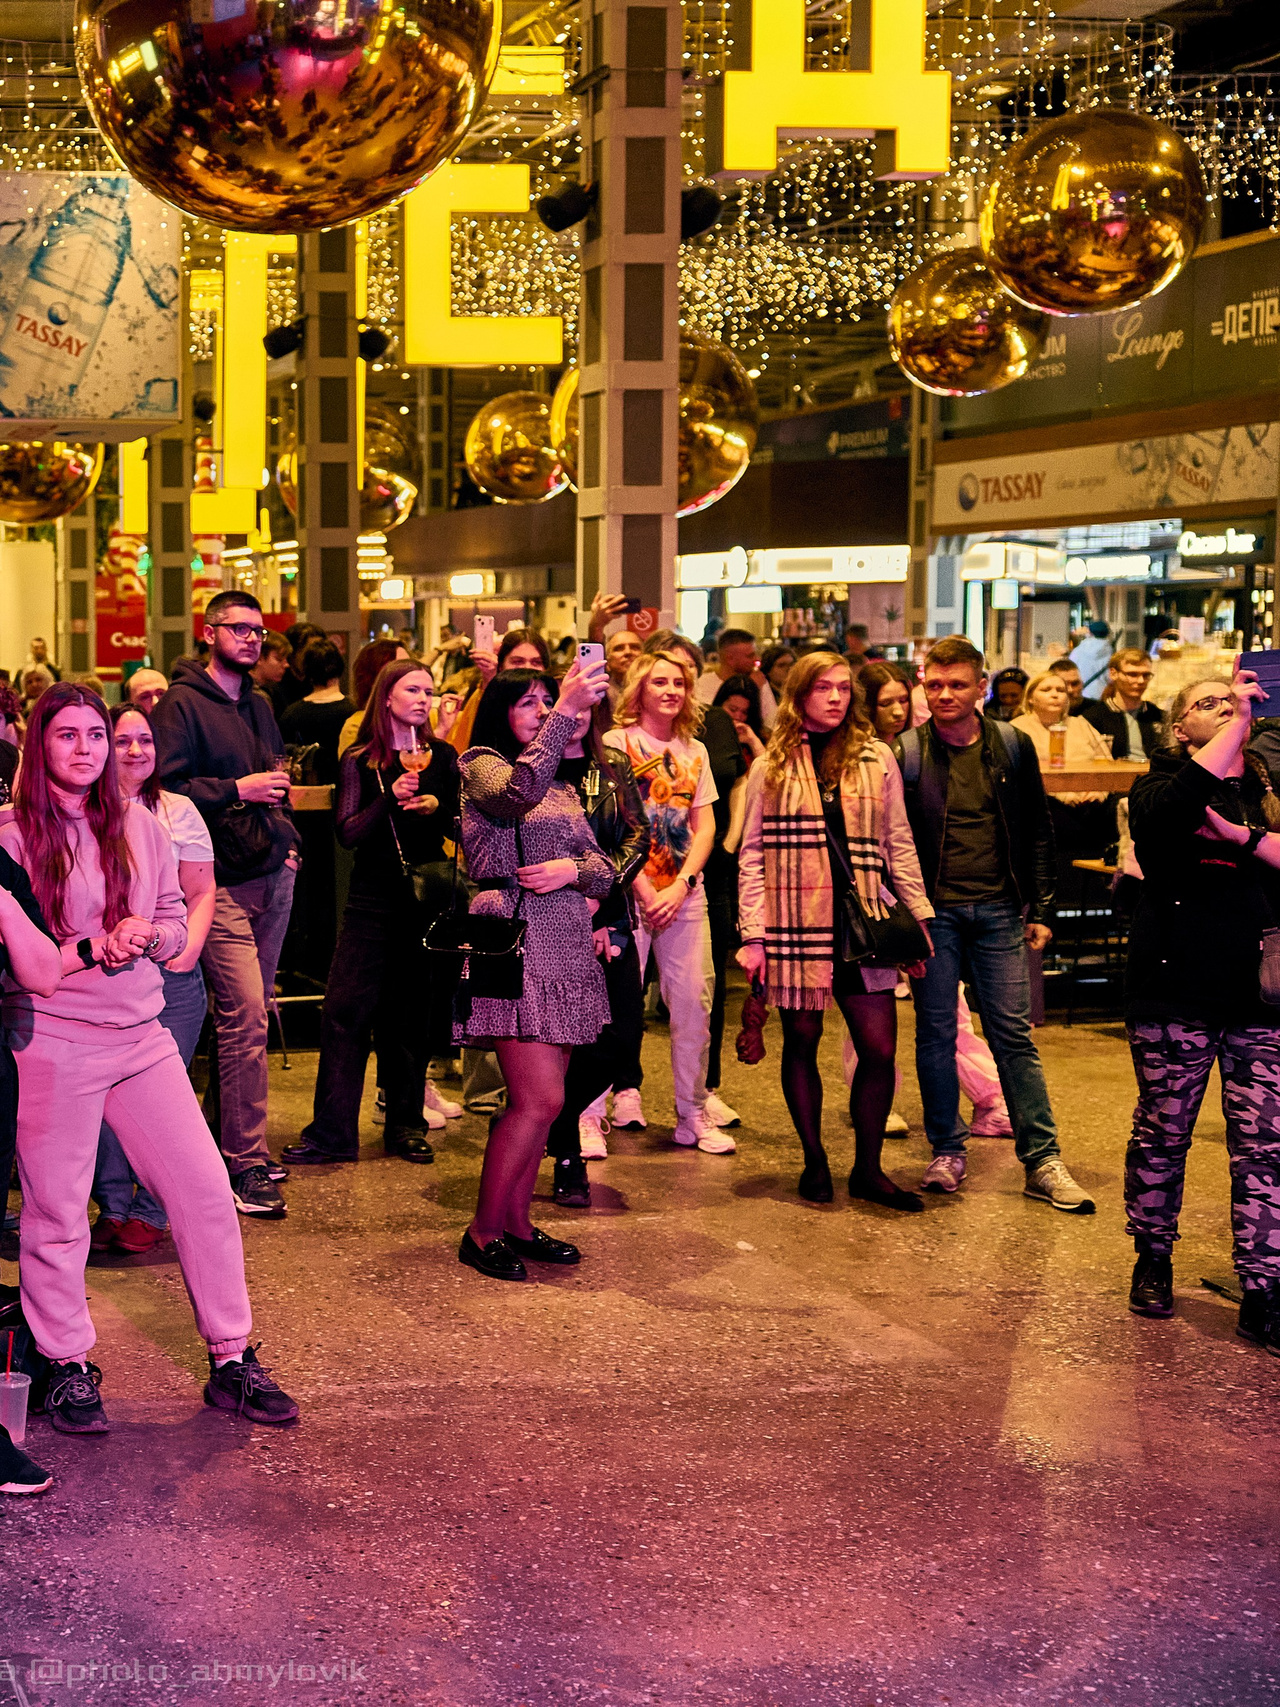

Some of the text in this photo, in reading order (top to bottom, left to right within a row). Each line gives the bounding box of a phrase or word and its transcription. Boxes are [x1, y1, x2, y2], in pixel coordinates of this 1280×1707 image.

[15, 313, 88, 358] TASSAY
[1106, 312, 1184, 371] Lounge
[980, 471, 1046, 504] TASSAY
